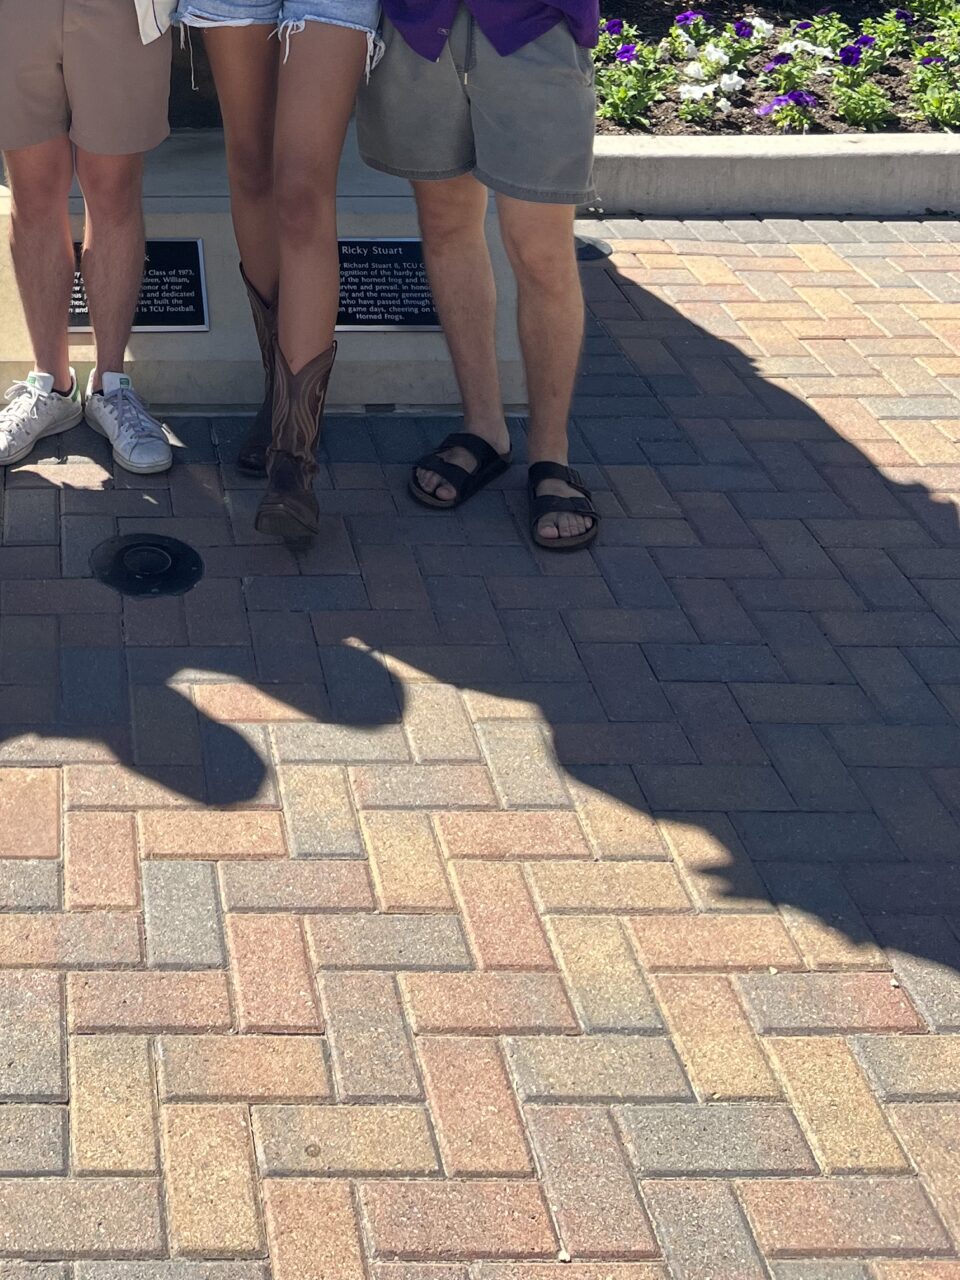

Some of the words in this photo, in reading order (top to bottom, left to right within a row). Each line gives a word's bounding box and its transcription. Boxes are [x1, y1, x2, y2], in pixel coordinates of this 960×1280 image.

[341, 245, 368, 257] Ricky
[372, 245, 403, 255] Stuart
[393, 269, 413, 277] hardy
[162, 276, 190, 284] William,
[388, 277, 403, 285] frog
[376, 298, 400, 306] passed
[389, 306, 419, 314] cheering
